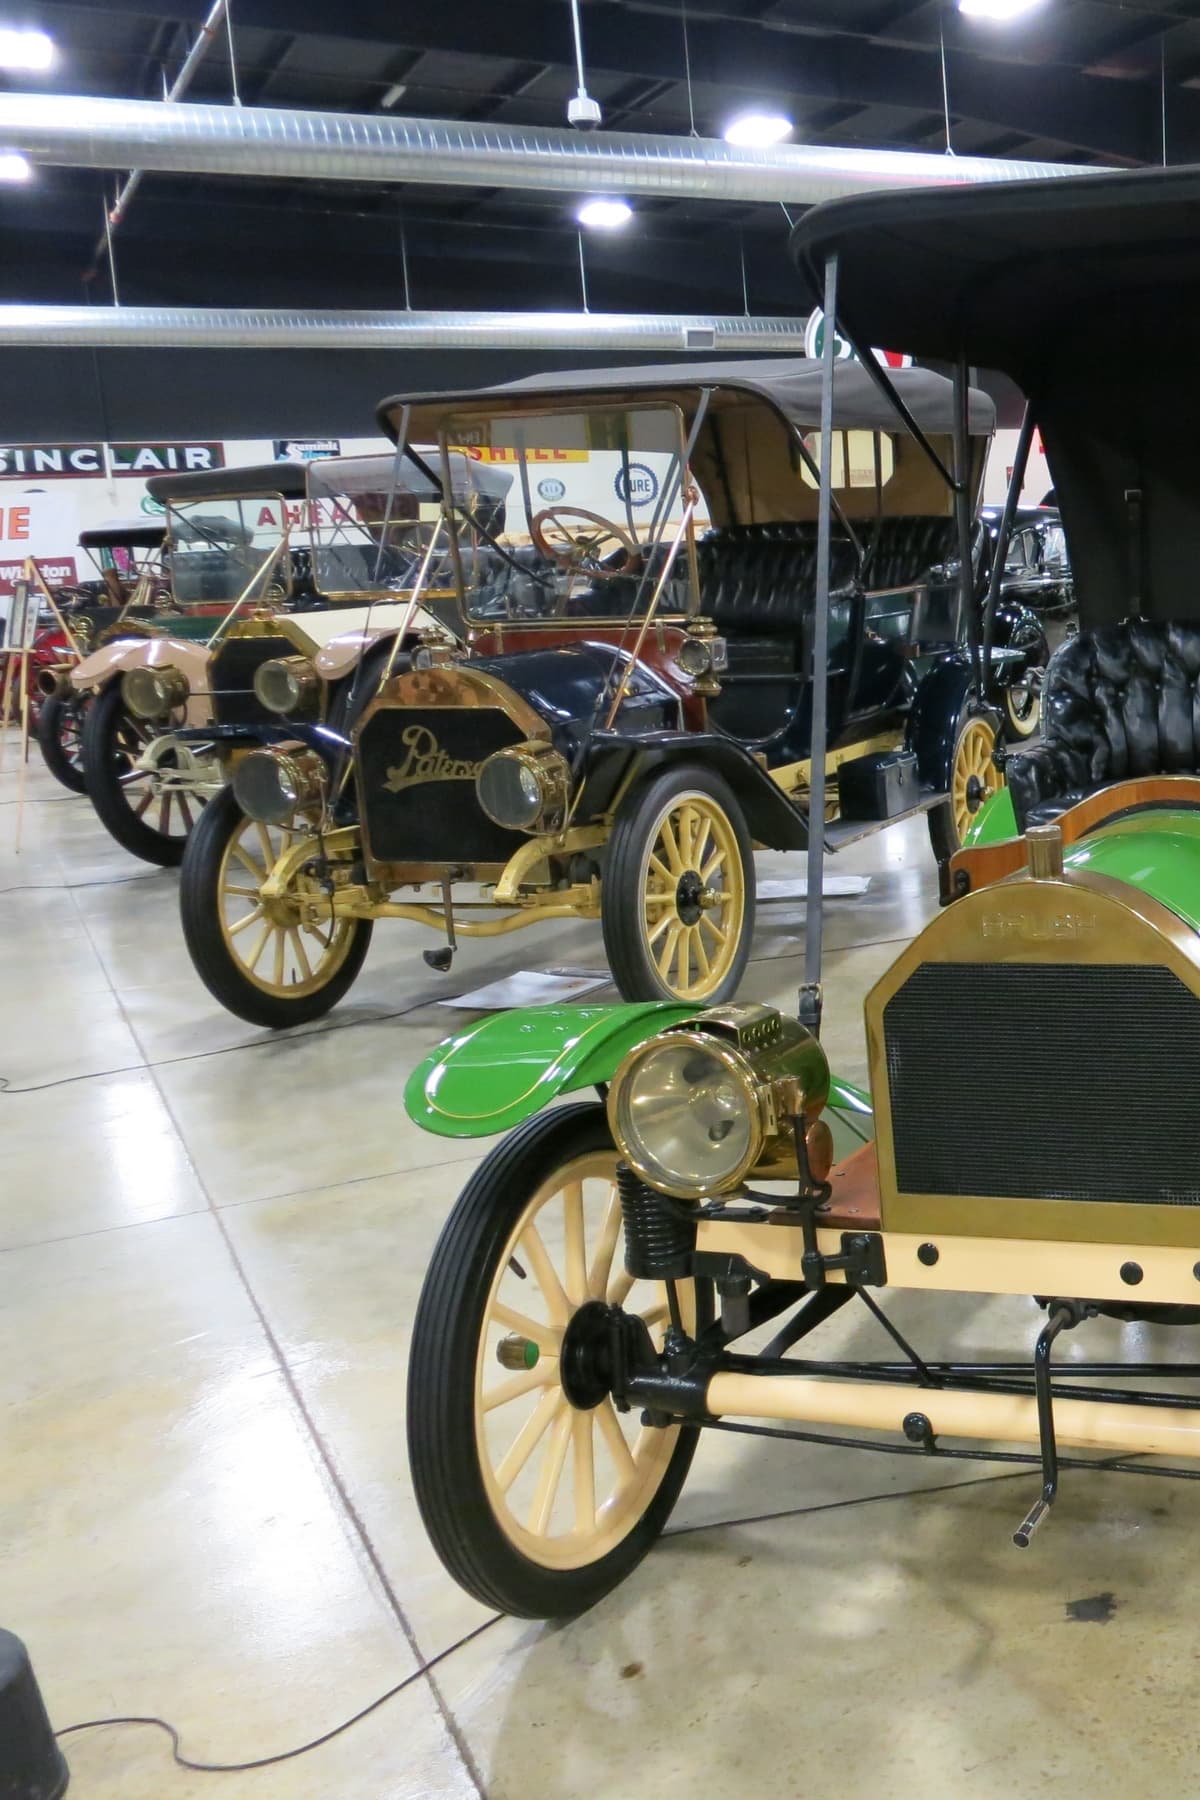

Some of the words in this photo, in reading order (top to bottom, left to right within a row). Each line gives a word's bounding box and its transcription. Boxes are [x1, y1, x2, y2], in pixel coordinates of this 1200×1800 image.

[628, 479, 651, 493] URE
[257, 500, 364, 527] AHEA
[0, 563, 72, 581] Witon
[386, 725, 486, 782] Paterso
